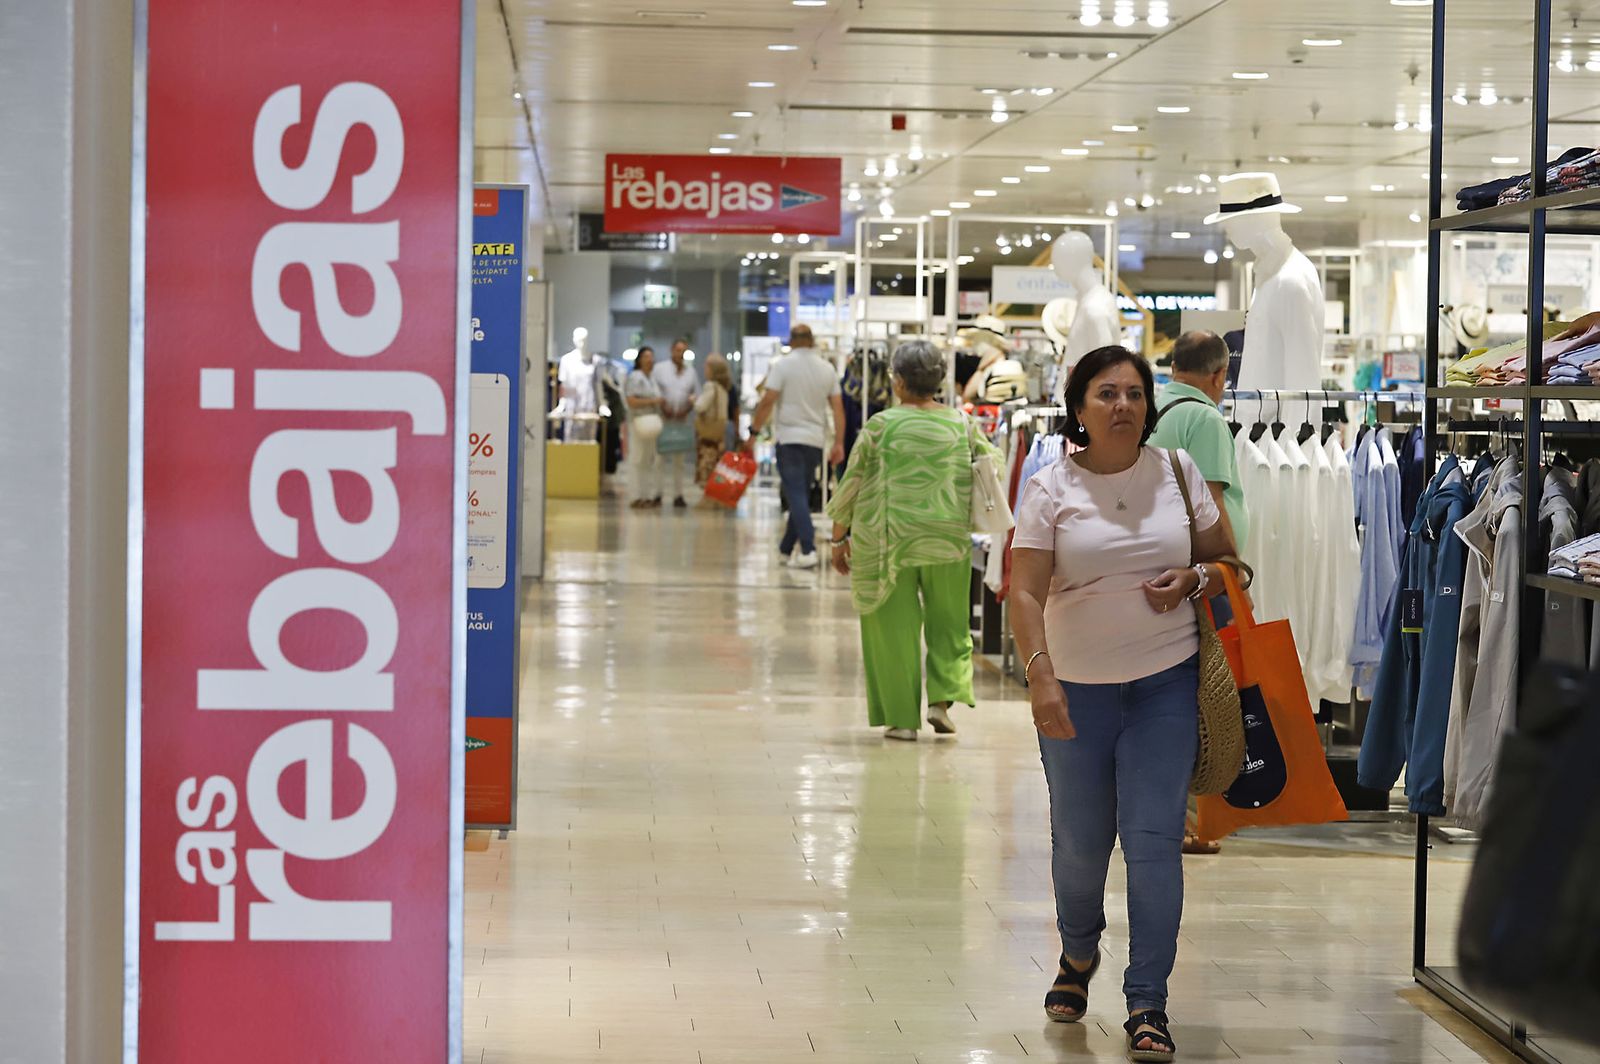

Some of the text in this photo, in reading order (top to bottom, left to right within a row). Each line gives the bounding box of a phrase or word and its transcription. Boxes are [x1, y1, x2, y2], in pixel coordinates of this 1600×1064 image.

[612, 163, 645, 180] Las
[611, 171, 774, 219] rebajas
[492, 259, 519, 267] TEXTO
[198, 81, 447, 942] rebajas
[468, 621, 493, 631] AQUÍ
[154, 775, 238, 941] Las
